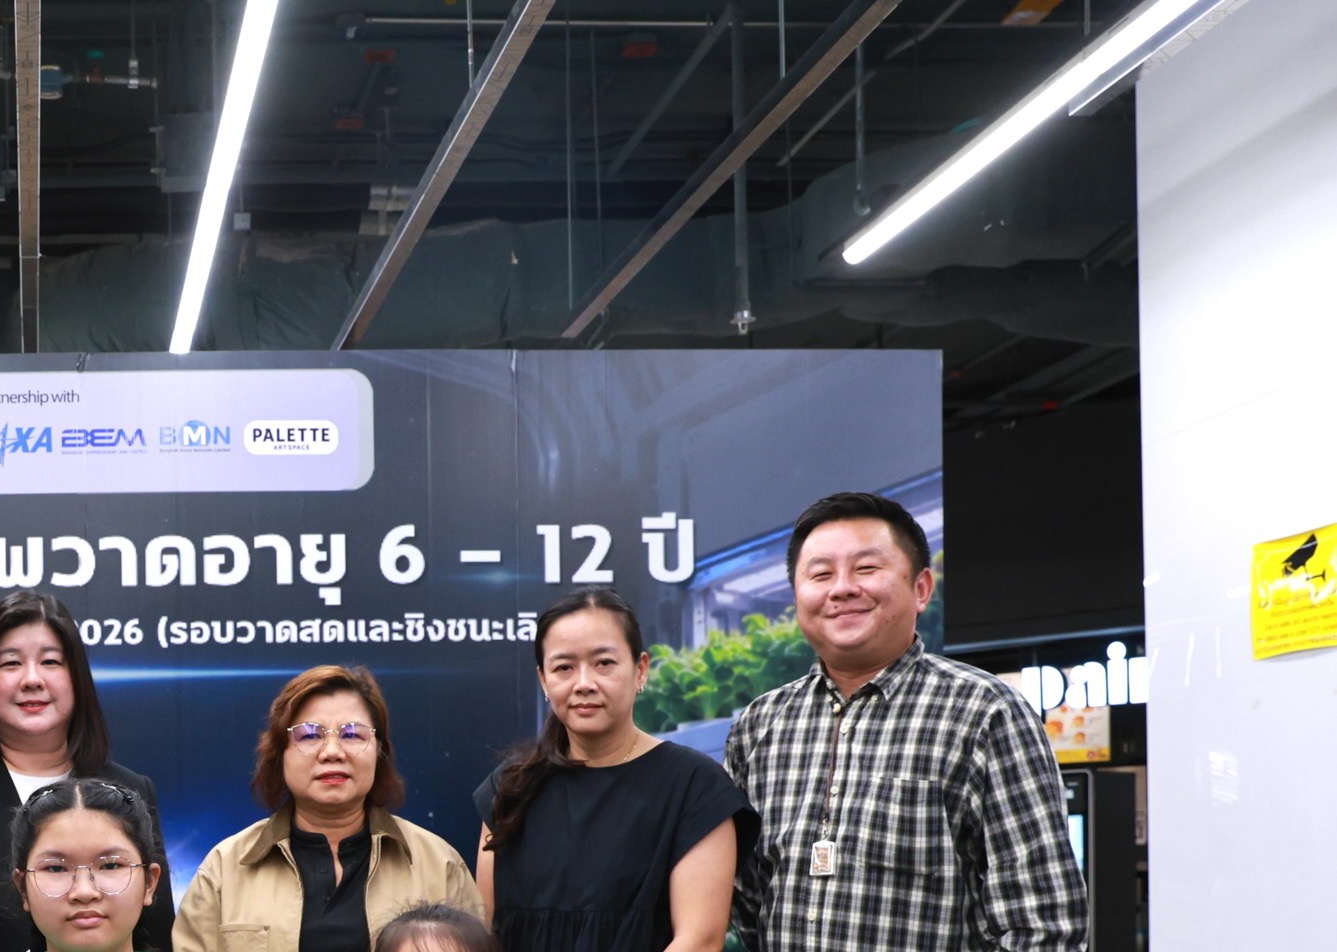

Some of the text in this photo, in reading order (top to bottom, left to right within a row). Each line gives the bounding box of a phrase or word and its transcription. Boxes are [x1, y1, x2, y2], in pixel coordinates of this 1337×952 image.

[51, 389, 80, 403] with
[61, 428, 147, 448] BEM
[159, 420, 231, 447] BMN
[252, 428, 331, 443] PALETTE
[379, 523, 426, 585] 6
[536, 523, 614, 584] 12
[641, 511, 696, 584] ปี
[157, 612, 538, 648] (รอบวาดสดและชิงชนะเลิ
